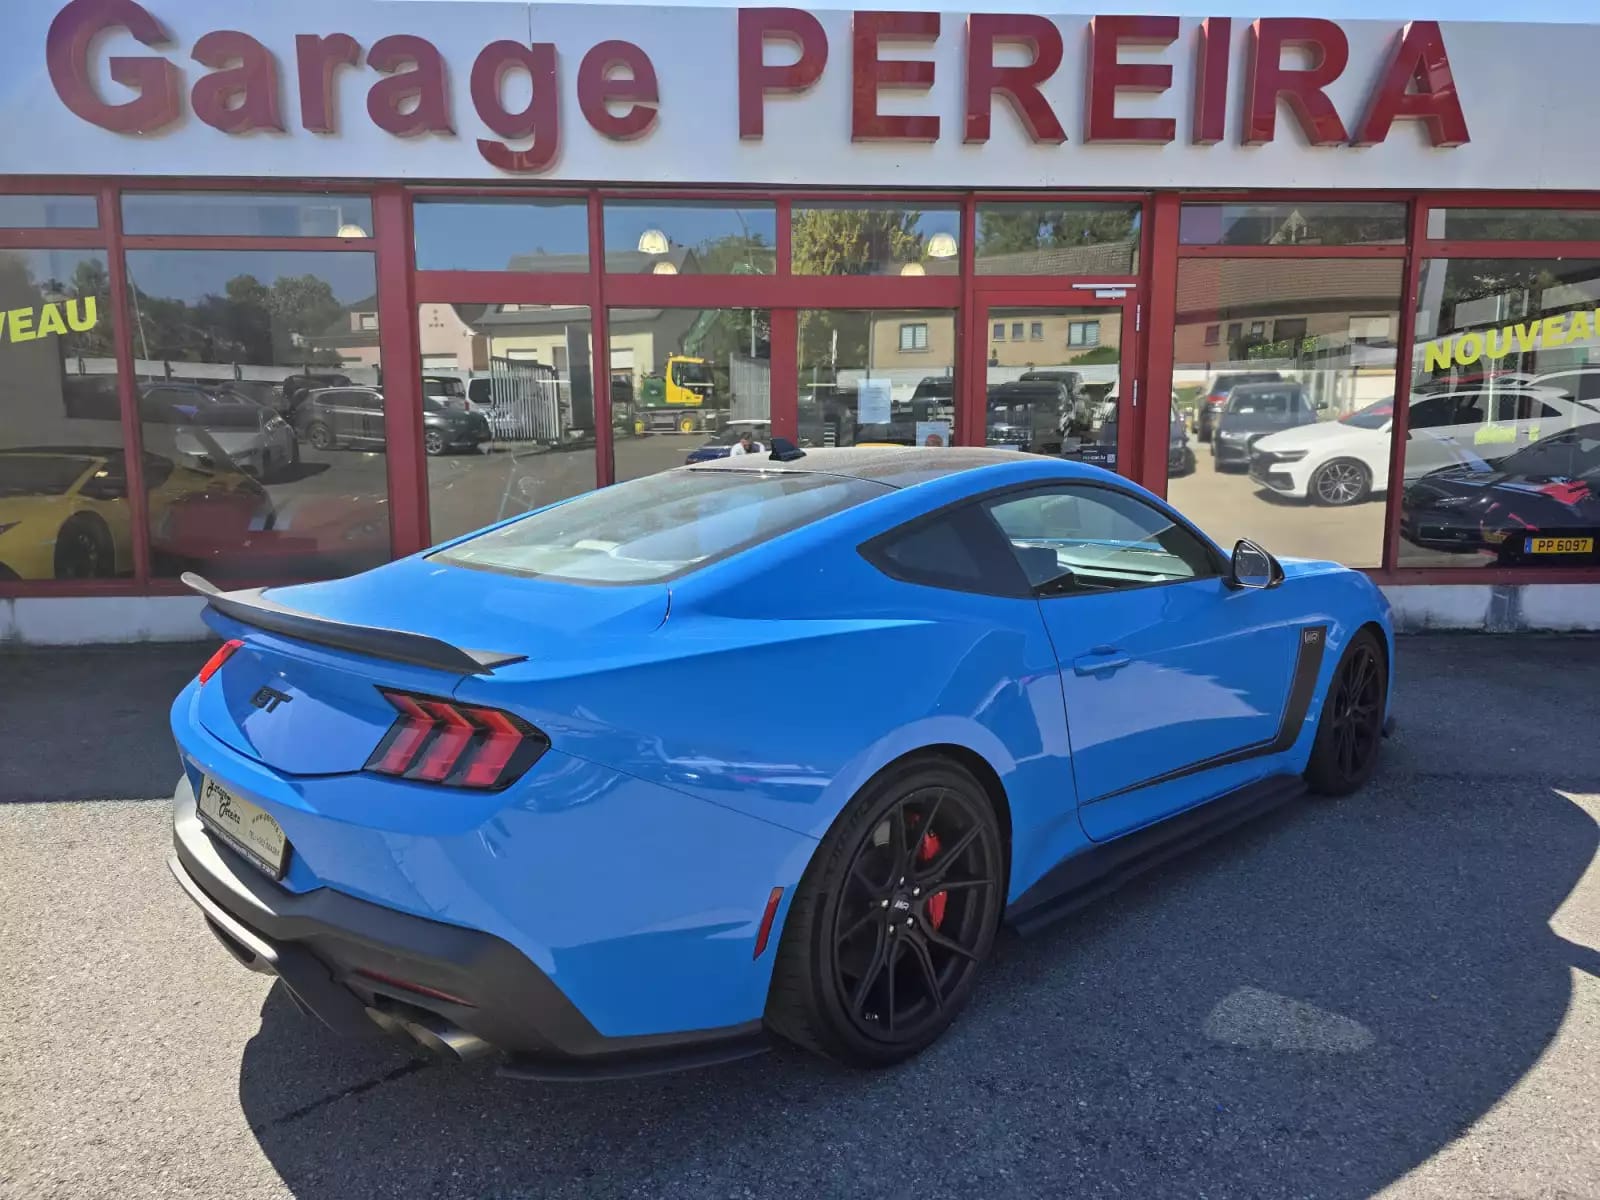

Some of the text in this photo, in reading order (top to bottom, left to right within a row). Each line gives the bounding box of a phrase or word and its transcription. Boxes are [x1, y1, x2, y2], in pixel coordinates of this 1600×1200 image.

[46, 0, 1471, 174] Garage PEREIRA
[0, 296, 97, 342] EAU
[1424, 307, 1600, 372] NOUVEA
[1538, 540, 1554, 552] PP
[1557, 540, 1588, 552] 6097
[250, 686, 293, 714] GT
